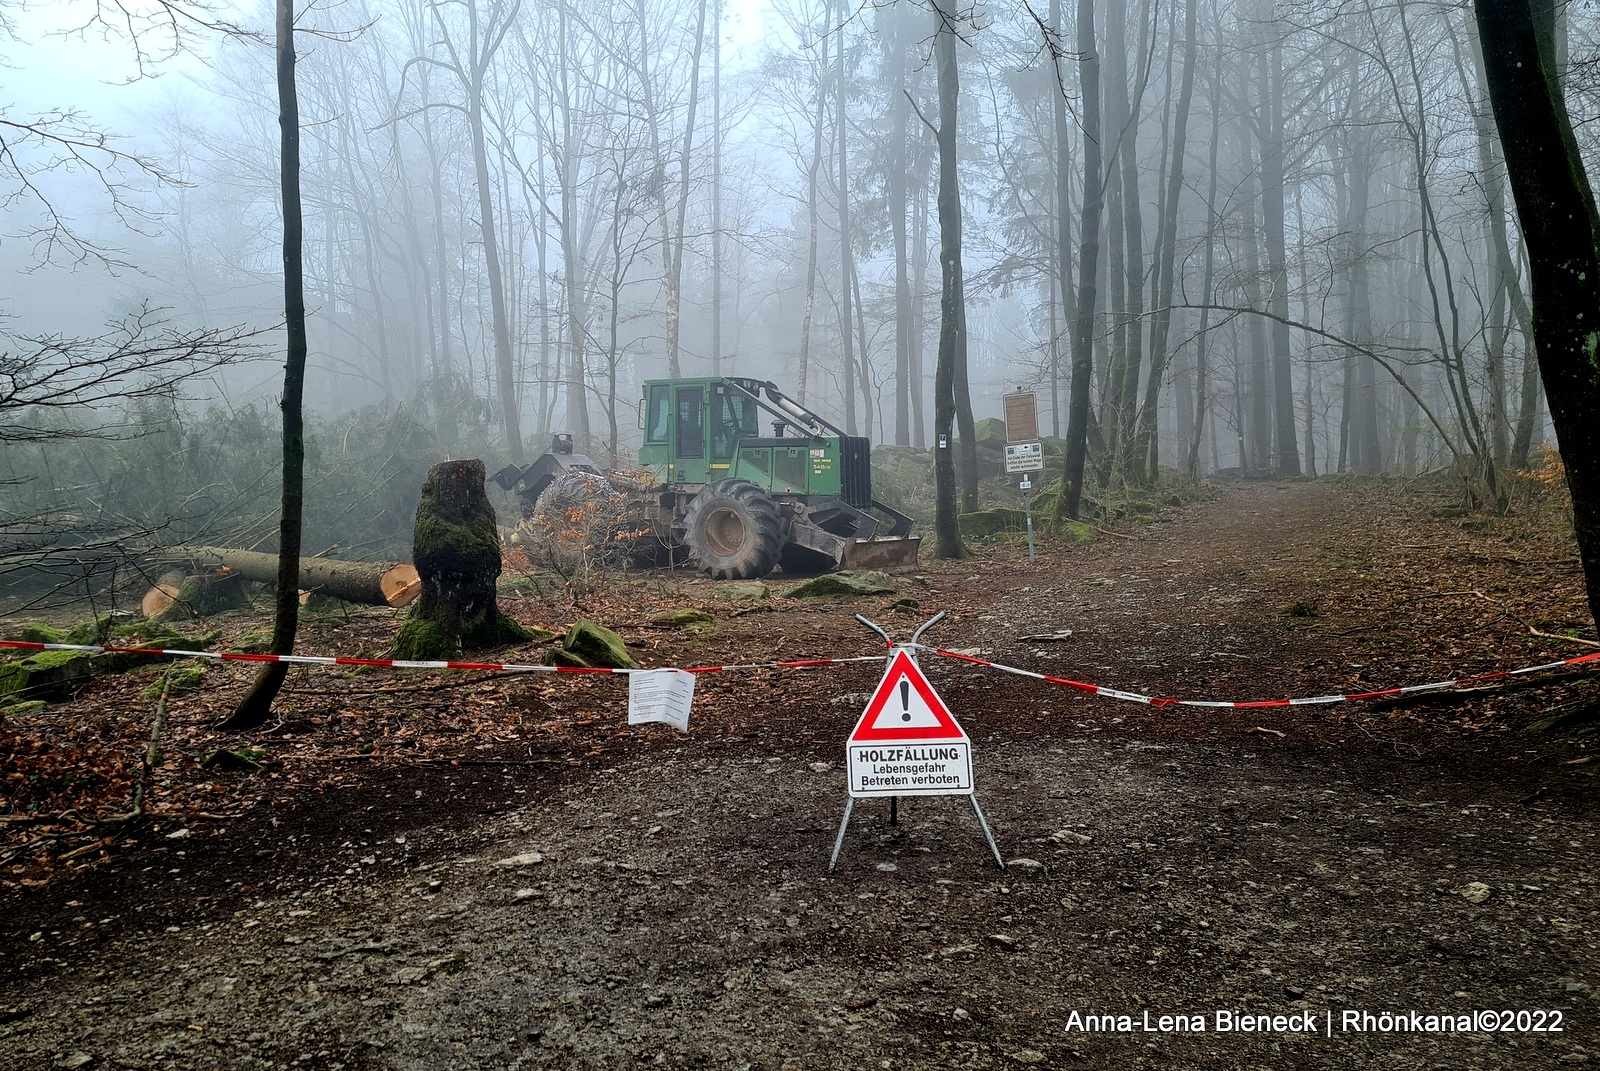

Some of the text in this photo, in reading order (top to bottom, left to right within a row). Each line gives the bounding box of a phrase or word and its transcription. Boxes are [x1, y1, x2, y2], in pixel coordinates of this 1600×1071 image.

[860, 746, 959, 762] HOLZFÄLLUNG
[873, 762, 946, 775] Lebensgefahr
[862, 774, 960, 786] Betreten verboten
